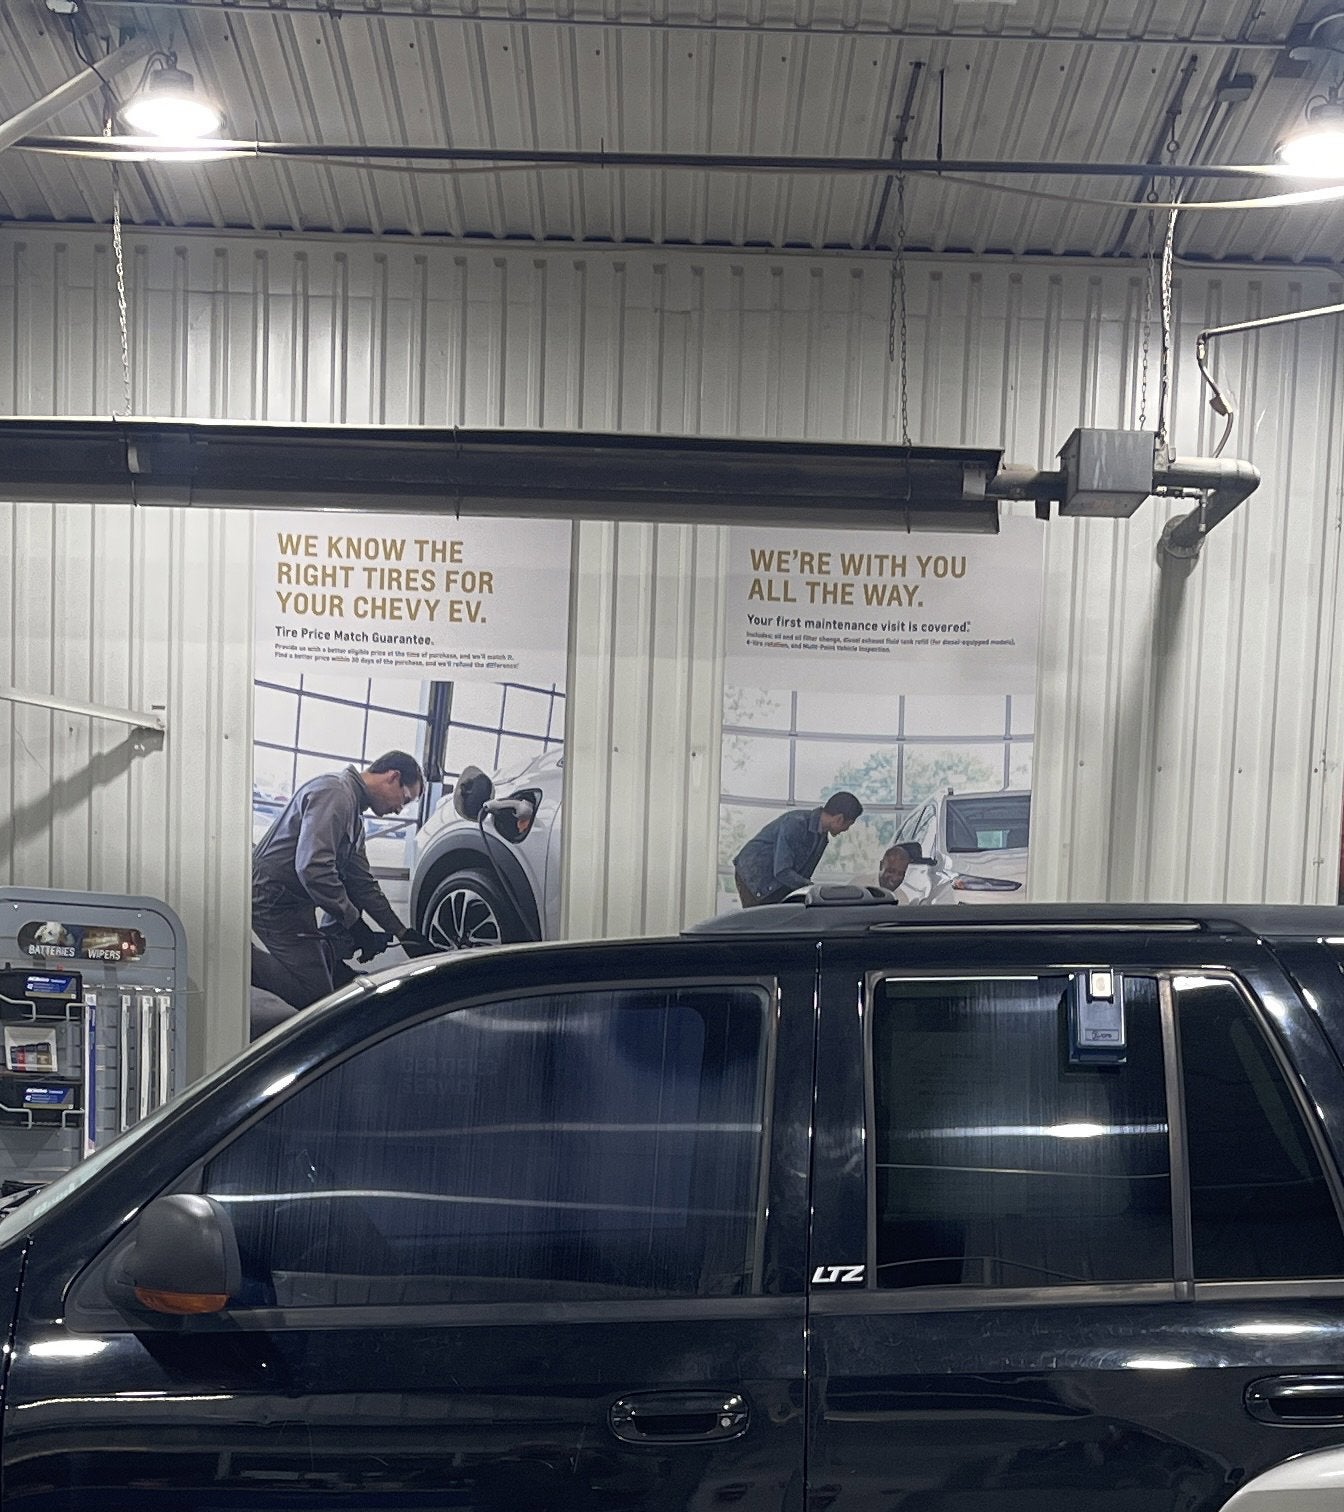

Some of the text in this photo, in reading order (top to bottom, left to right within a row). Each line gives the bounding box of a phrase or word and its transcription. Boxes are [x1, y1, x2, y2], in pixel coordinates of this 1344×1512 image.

[277, 532, 463, 563] WE KNOW THE
[277, 562, 493, 594] RIGHT TIRES FOR
[750, 549, 966, 578] WE'RE WITH YOU
[276, 591, 486, 623] YOUR CHEVY EV.
[748, 578, 923, 607] ALL THE WAY.
[275, 626, 434, 645] Tire Price Match Guarantee.
[747, 613, 773, 626] Your
[776, 616, 801, 628] first
[804, 618, 878, 631] maintenance
[881, 620, 906, 632] visit
[908, 621, 917, 632] is
[28, 944, 121, 960] BATTERIES WIPERS
[812, 1265, 865, 1283] LTZ
